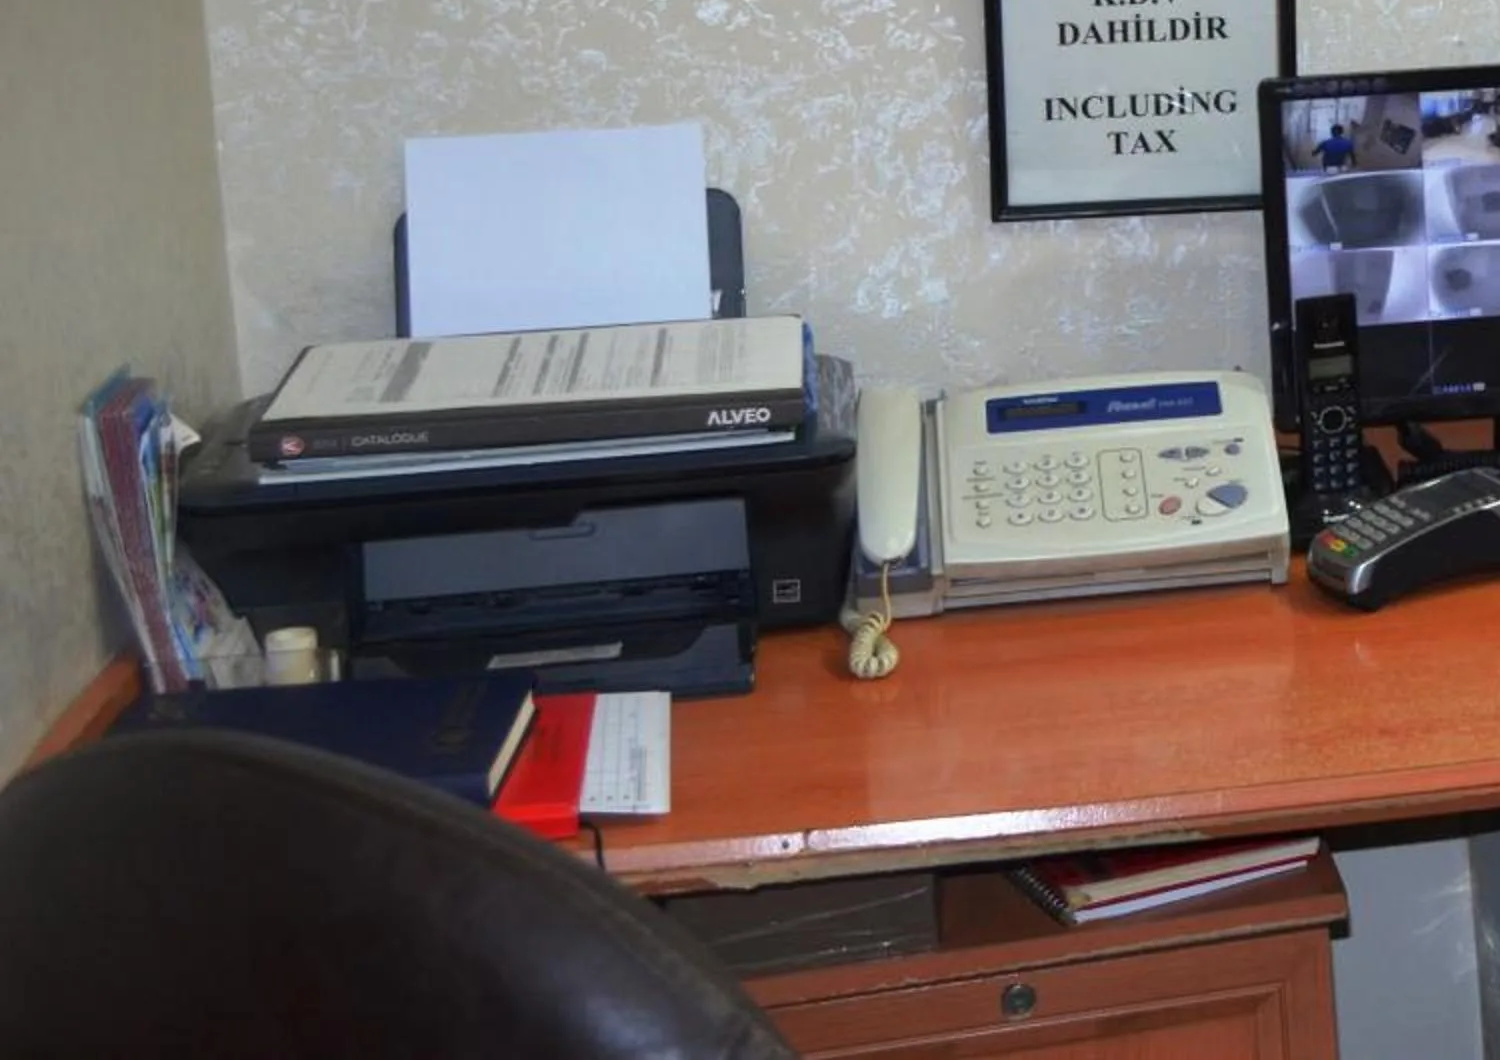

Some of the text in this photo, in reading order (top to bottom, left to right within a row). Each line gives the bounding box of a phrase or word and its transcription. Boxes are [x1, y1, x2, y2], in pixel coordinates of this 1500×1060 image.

[1057, 12, 1229, 46] DAHİLDİR
[1107, 129, 1179, 155] TAX
[706, 408, 772, 427] ALVEO
[351, 431, 430, 448] CATALOGUE
